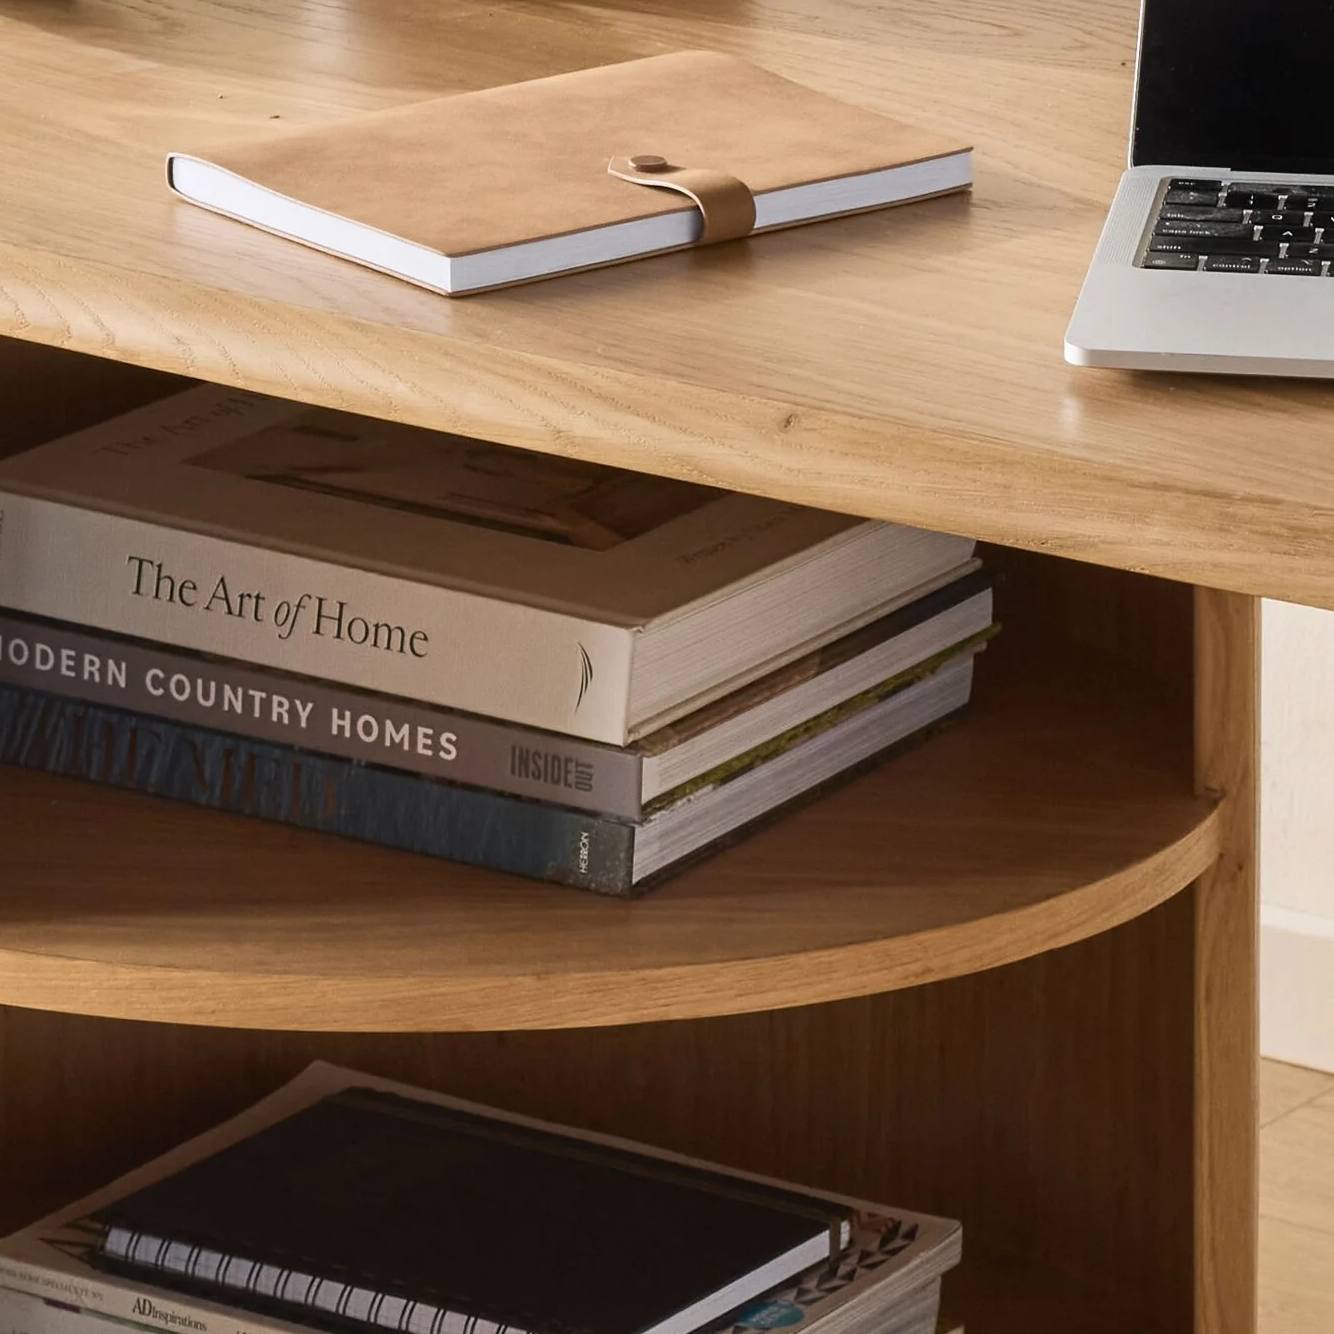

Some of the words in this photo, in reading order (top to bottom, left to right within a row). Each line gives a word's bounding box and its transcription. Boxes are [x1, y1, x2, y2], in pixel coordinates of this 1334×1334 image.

[128, 555, 198, 607] The
[203, 574, 266, 623] Art
[274, 593, 312, 640] of
[312, 596, 429, 658] Home
[145, 668, 314, 729] COUNTRY
[331, 707, 458, 761] HOMES
[510, 745, 574, 789] INSIDE
[574, 758, 594, 793] OUT
